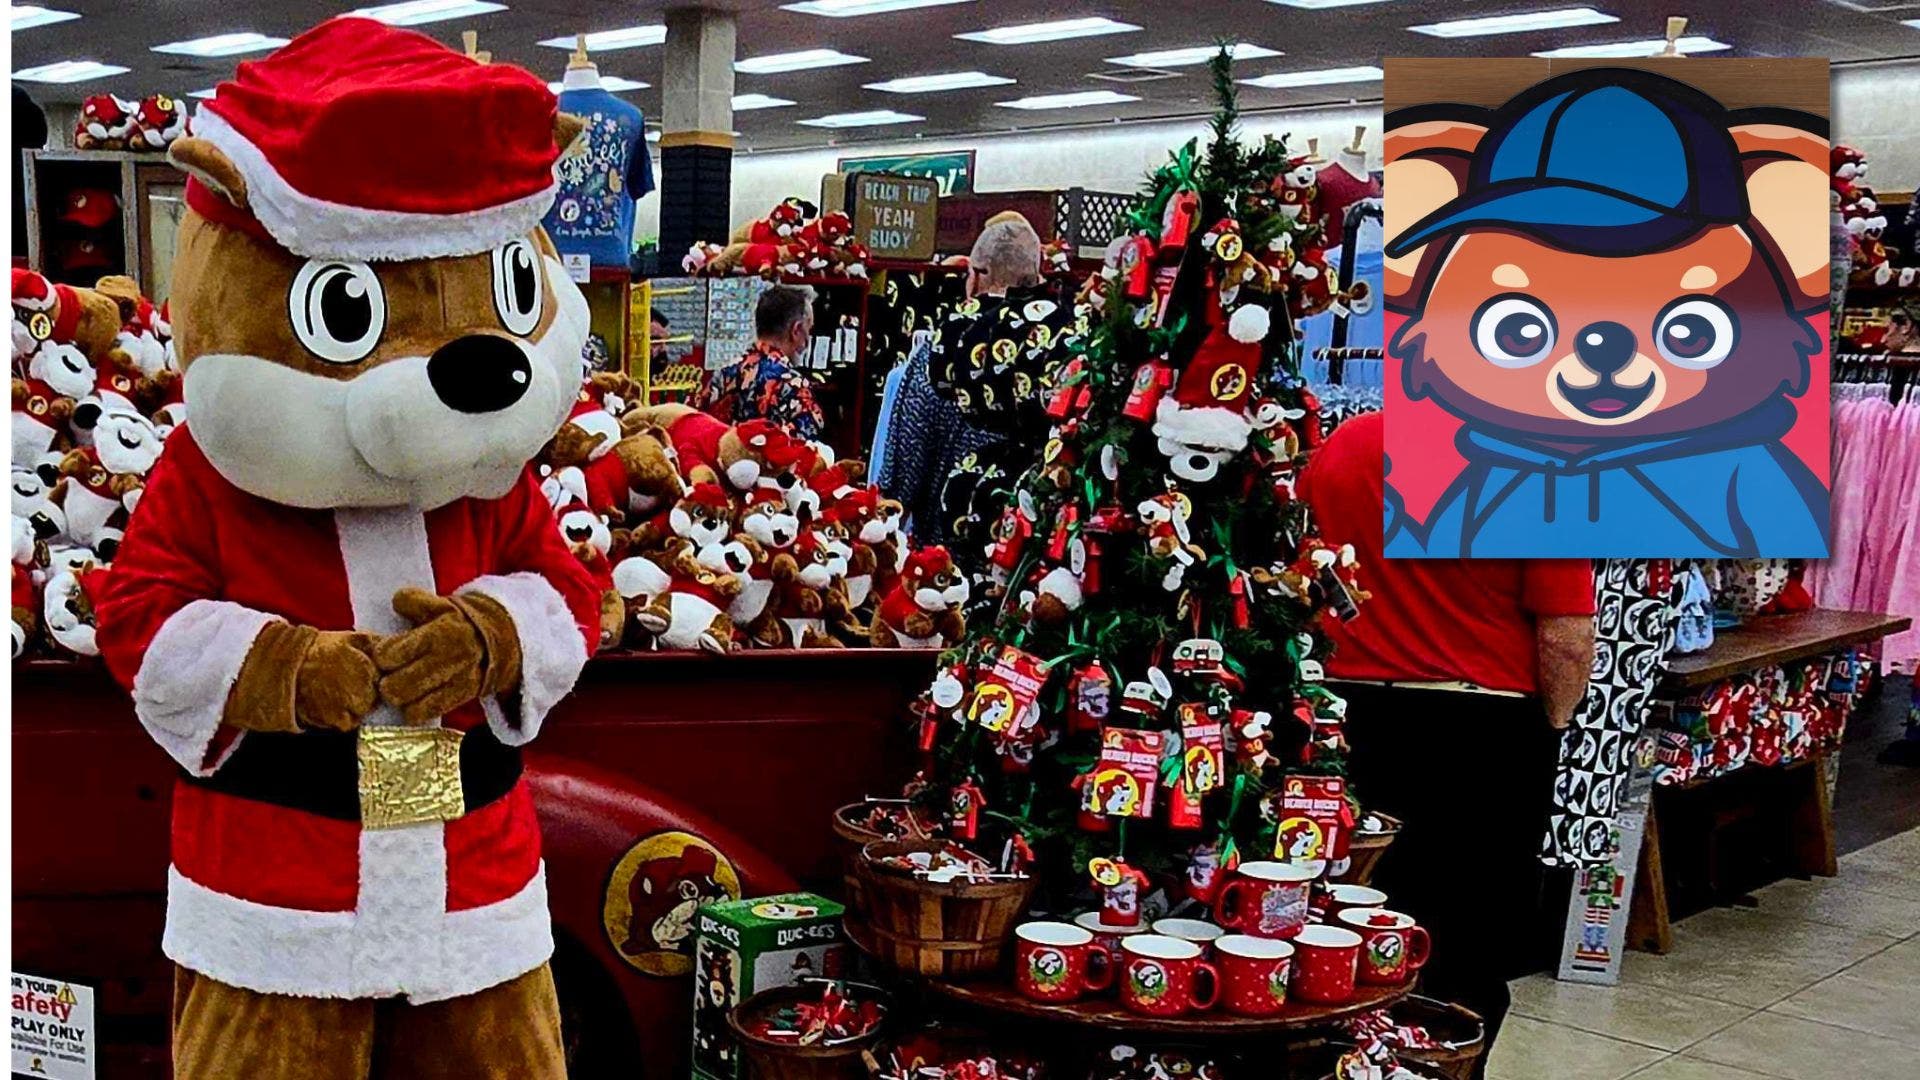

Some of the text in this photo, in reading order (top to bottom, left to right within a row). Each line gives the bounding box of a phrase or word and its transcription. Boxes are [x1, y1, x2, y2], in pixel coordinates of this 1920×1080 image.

[874, 206, 915, 229] YEAH
[869, 229, 912, 249] BUOY
[25, 979, 58, 995] YOUR
[11, 992, 72, 1023] afety
[11, 1016, 85, 1042] PLAY ONLY
